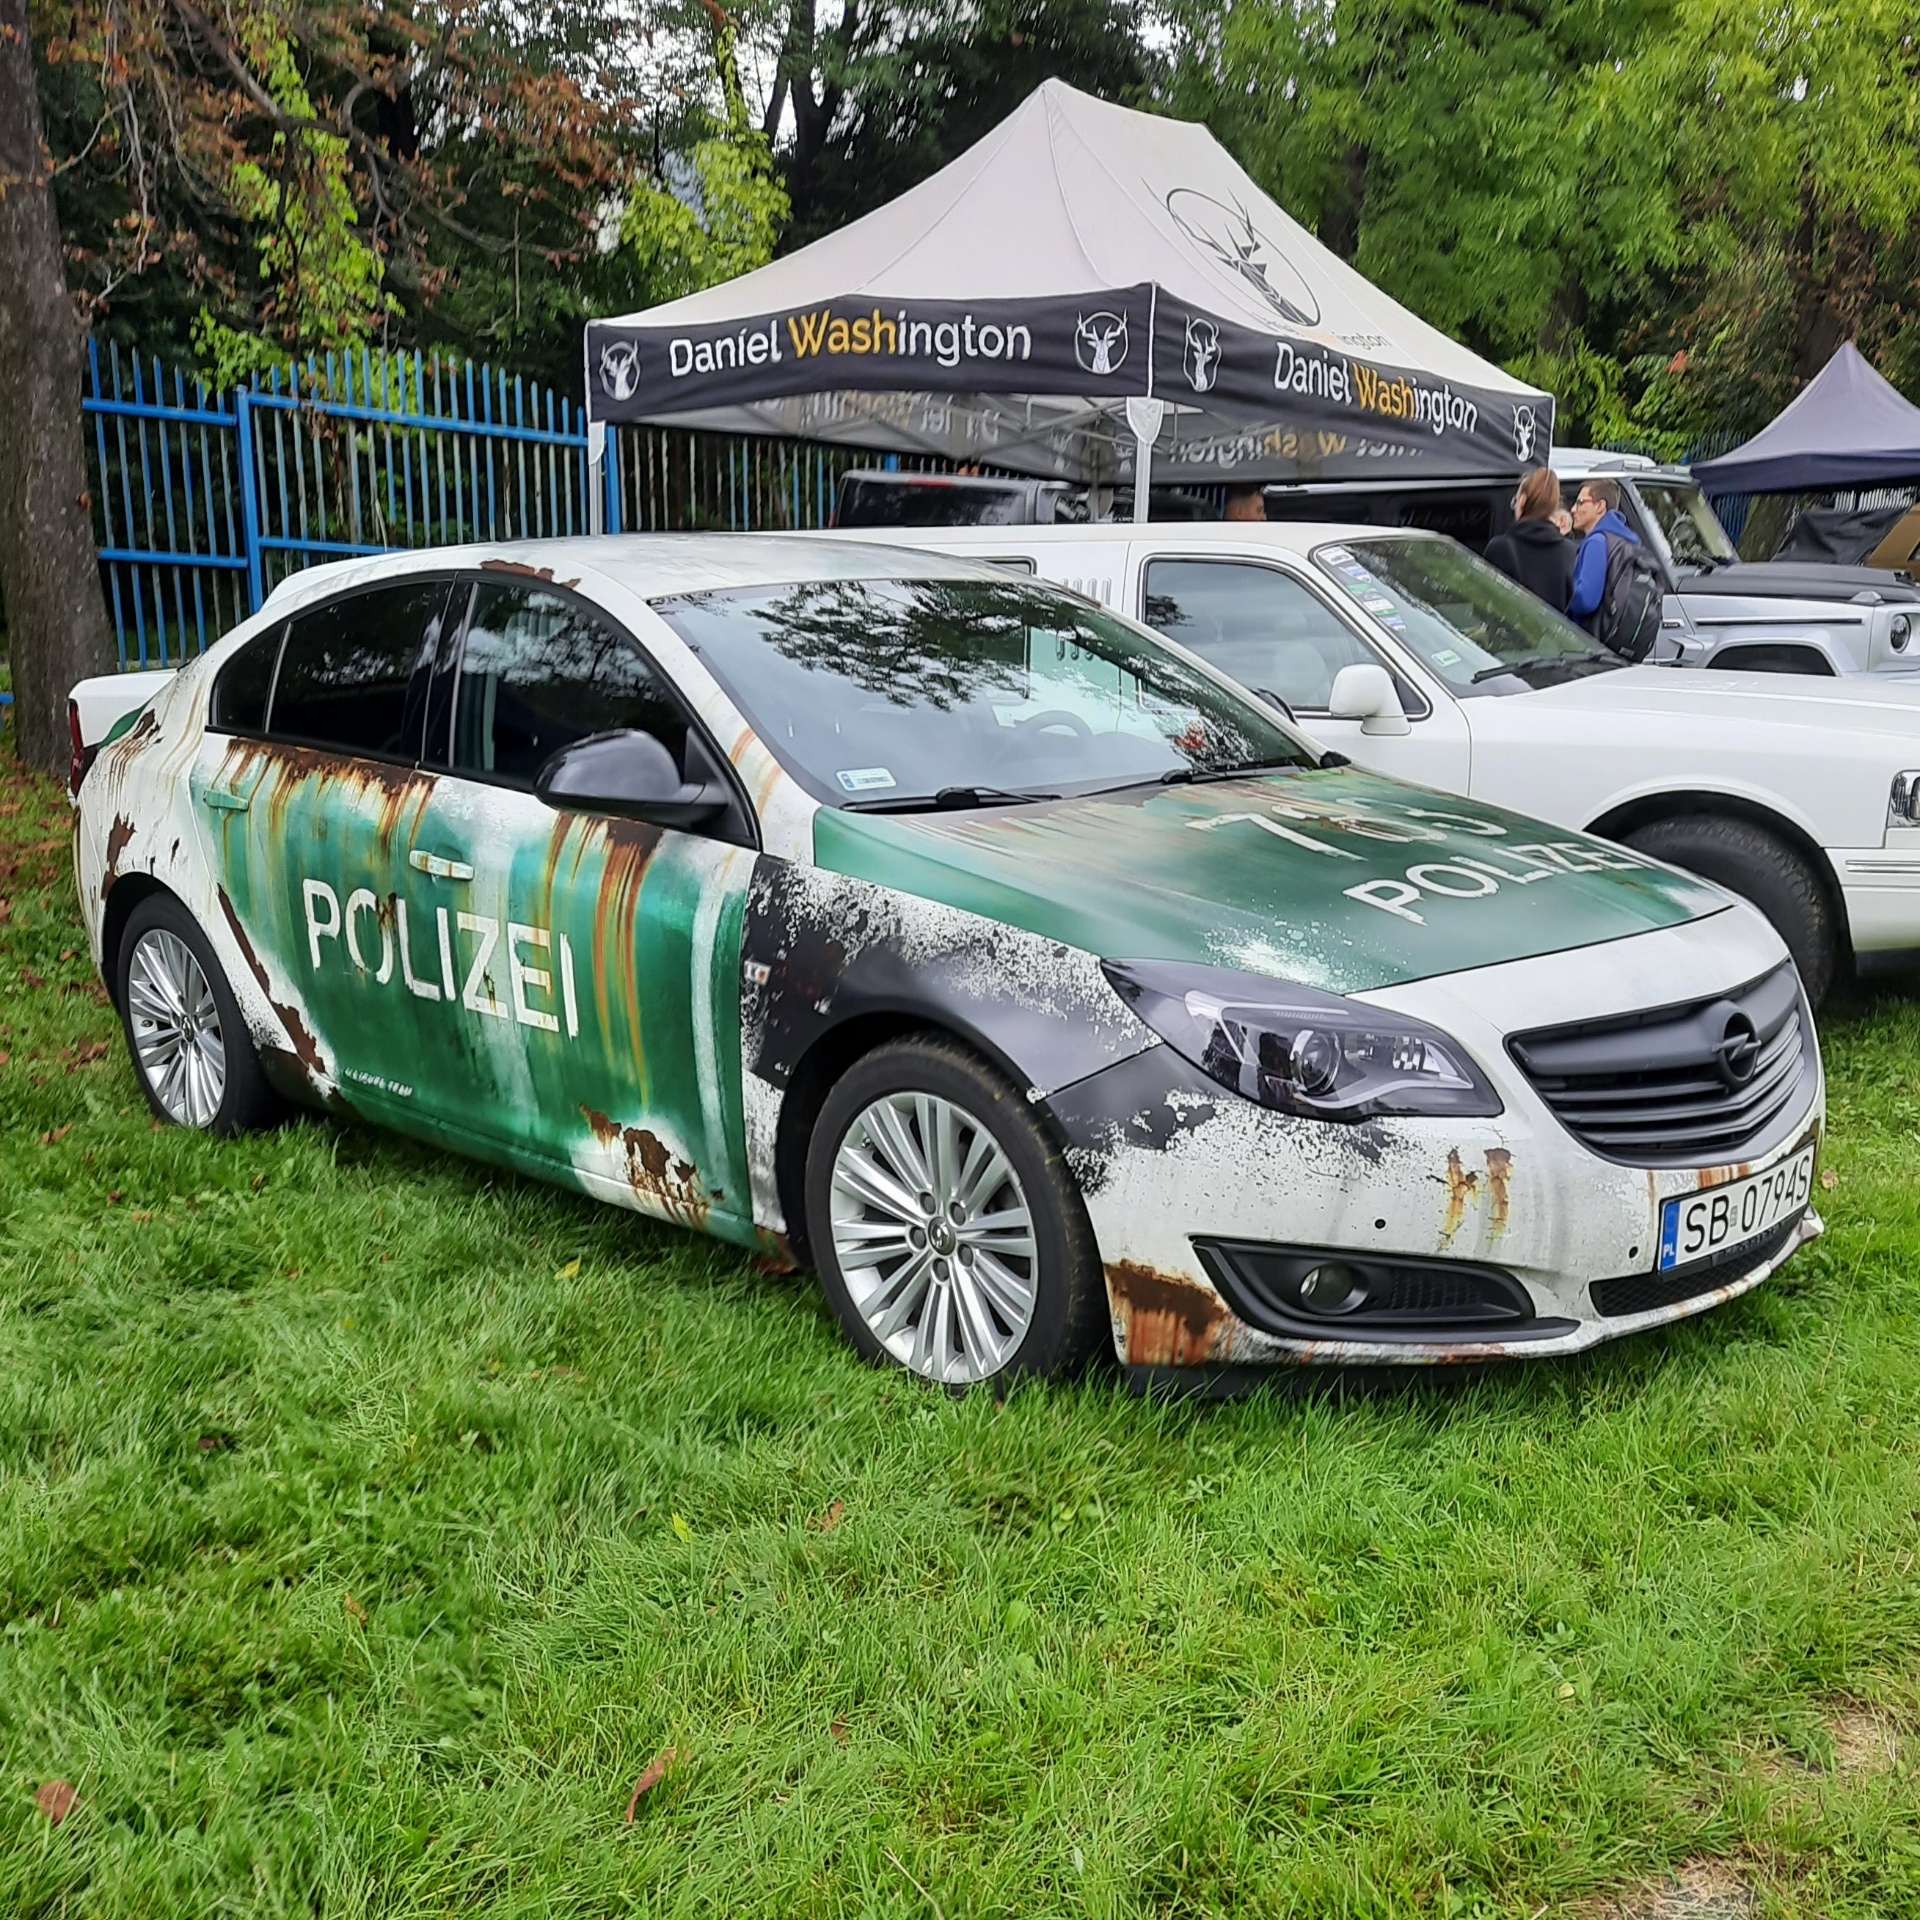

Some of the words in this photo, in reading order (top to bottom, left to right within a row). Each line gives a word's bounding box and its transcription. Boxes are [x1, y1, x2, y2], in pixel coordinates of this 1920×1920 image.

[787, 308, 1032, 368] Washington
[1274, 341, 1352, 405] Daniel
[1352, 362, 1478, 436] Washington
[1341, 842, 1657, 926] POLIZEI
[302, 877, 580, 1042] POLIZEI
[1662, 1242, 1675, 1259] PL
[1684, 1194, 1730, 1253] SB
